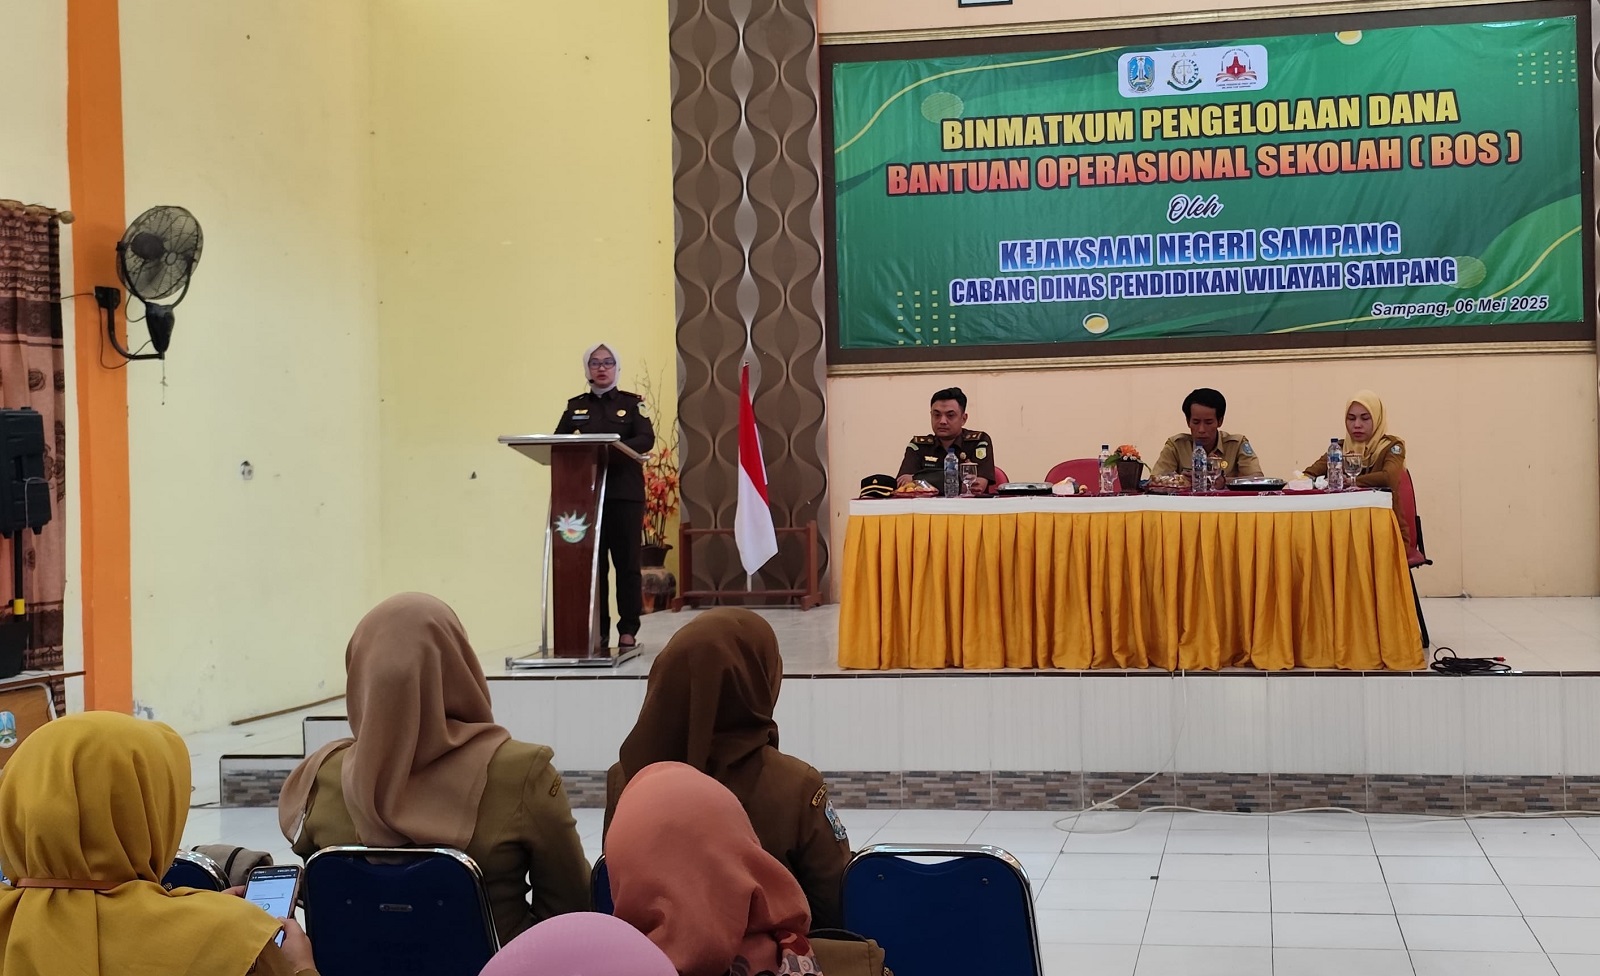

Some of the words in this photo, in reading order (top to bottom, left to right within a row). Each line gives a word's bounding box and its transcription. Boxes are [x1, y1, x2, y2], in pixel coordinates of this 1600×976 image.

[941, 109, 1135, 150] BINMATKUM
[1142, 96, 1361, 140] PENGELOLAAN
[1368, 91, 1459, 127] DANA
[887, 158, 1030, 195] BANTUAN
[1036, 147, 1251, 188] OPERASIONAL
[1256, 137, 1402, 176] SEKOLAH
[1430, 132, 1500, 166] BOS
[1167, 194, 1224, 224] Oleh
[1000, 235, 1152, 272] KEJAKSAAN
[1156, 230, 1255, 266] NEGERI
[1261, 222, 1400, 260] SAMPANG
[950, 279, 1036, 305] CABANG
[1040, 275, 1106, 301] DINAS
[1109, 269, 1240, 298] PENDIDIKAN
[1244, 263, 1341, 293] WILAYAH
[1346, 257, 1457, 287] SAMPANG
[1371, 301, 1451, 319] Sampang,
[1453, 299, 1473, 314] 06
[1478, 297, 1506, 313] Mei
[1510, 296, 1549, 311] 2025
